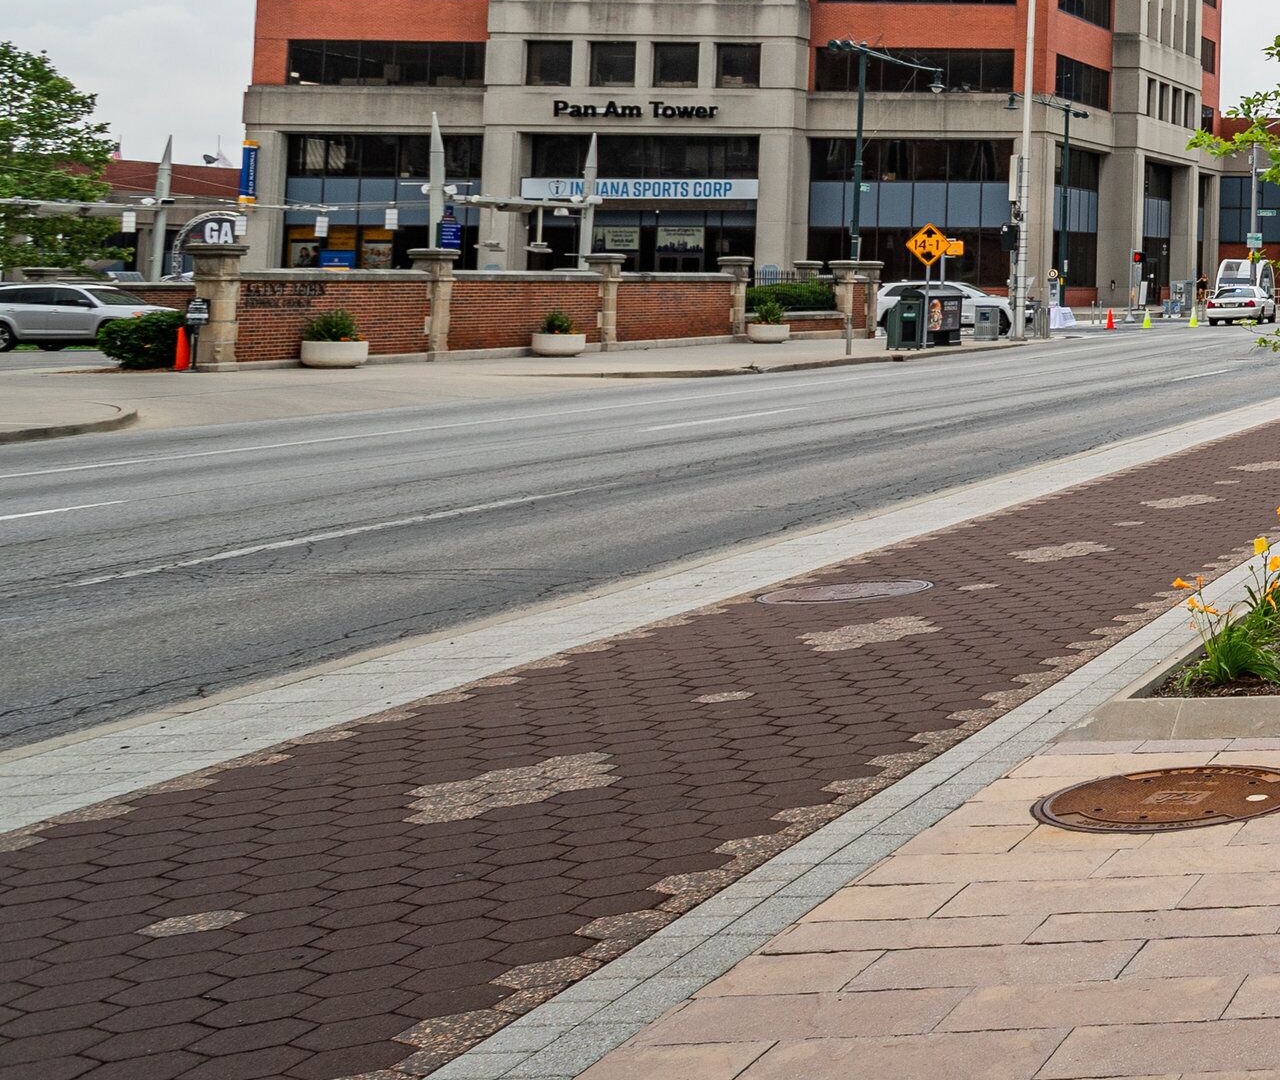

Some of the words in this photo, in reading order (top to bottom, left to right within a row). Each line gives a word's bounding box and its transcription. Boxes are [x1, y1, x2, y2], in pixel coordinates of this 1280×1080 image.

[553, 100, 597, 118] Pan
[602, 100, 643, 118] Am
[649, 101, 719, 119] Tower
[570, 181, 630, 197] INIANA
[633, 182, 689, 197] SPORTS
[693, 182, 733, 197] CORP
[204, 222, 234, 244] GA
